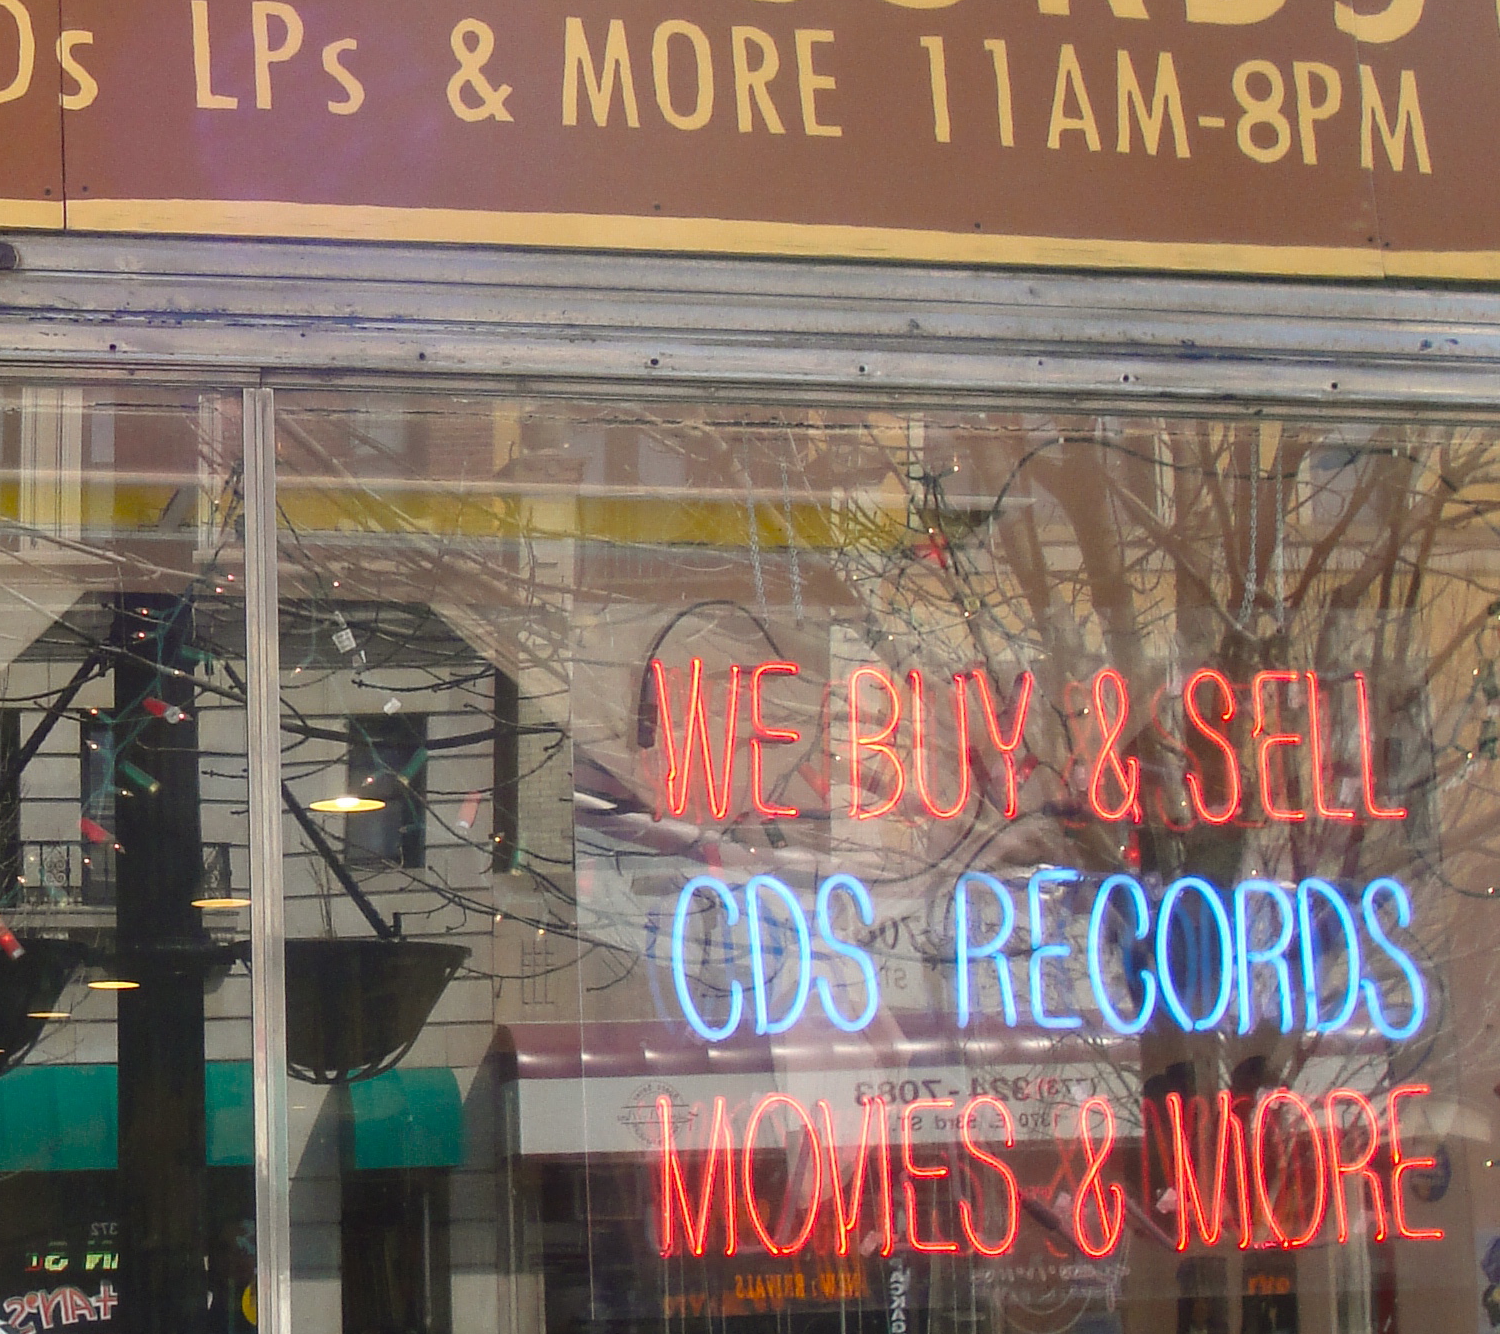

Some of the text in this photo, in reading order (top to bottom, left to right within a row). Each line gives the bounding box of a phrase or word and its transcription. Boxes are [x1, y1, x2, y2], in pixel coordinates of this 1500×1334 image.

[445, 17, 514, 124] &
[561, 15, 843, 140] MORE
[918, 34, 1432, 177] 11AM-8PM
[651, 657, 1408, 825] WE BUY & SELL
[670, 868, 1431, 1043] CDS RECORDS
[656, 1091, 1023, 1260] MOVIES
[1071, 1093, 1127, 1260] &
[1166, 1084, 1445, 1253] MORE
